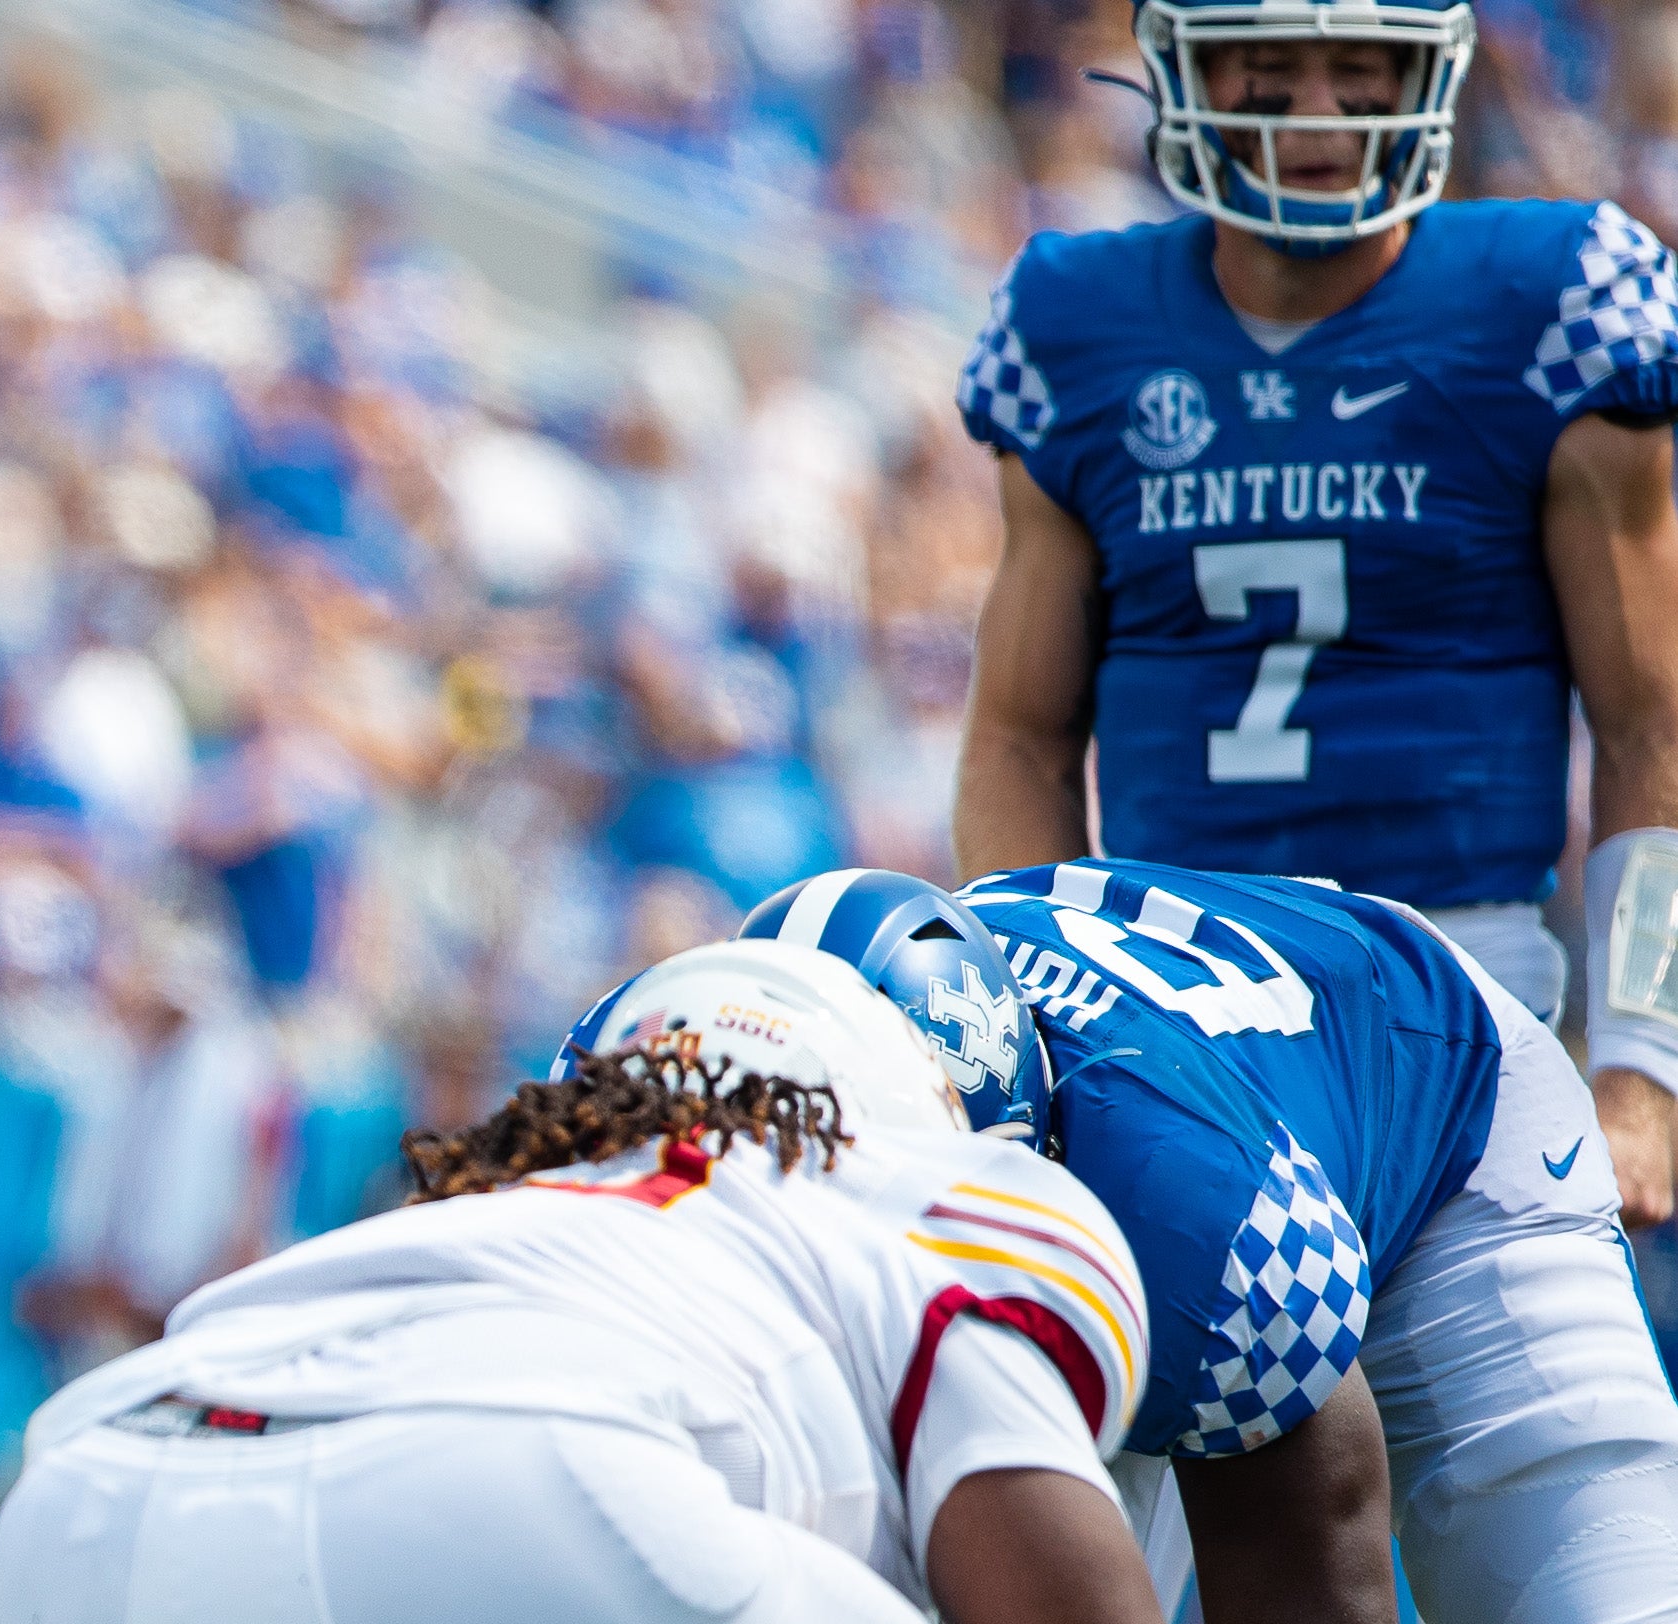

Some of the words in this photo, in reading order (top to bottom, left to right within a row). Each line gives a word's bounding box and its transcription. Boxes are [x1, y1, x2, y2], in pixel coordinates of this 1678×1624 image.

[1137, 372, 1208, 444] SEC
[1239, 370, 1296, 420] UK
[1138, 462, 1428, 533] KENTUCKY
[1193, 538, 1349, 783] 7
